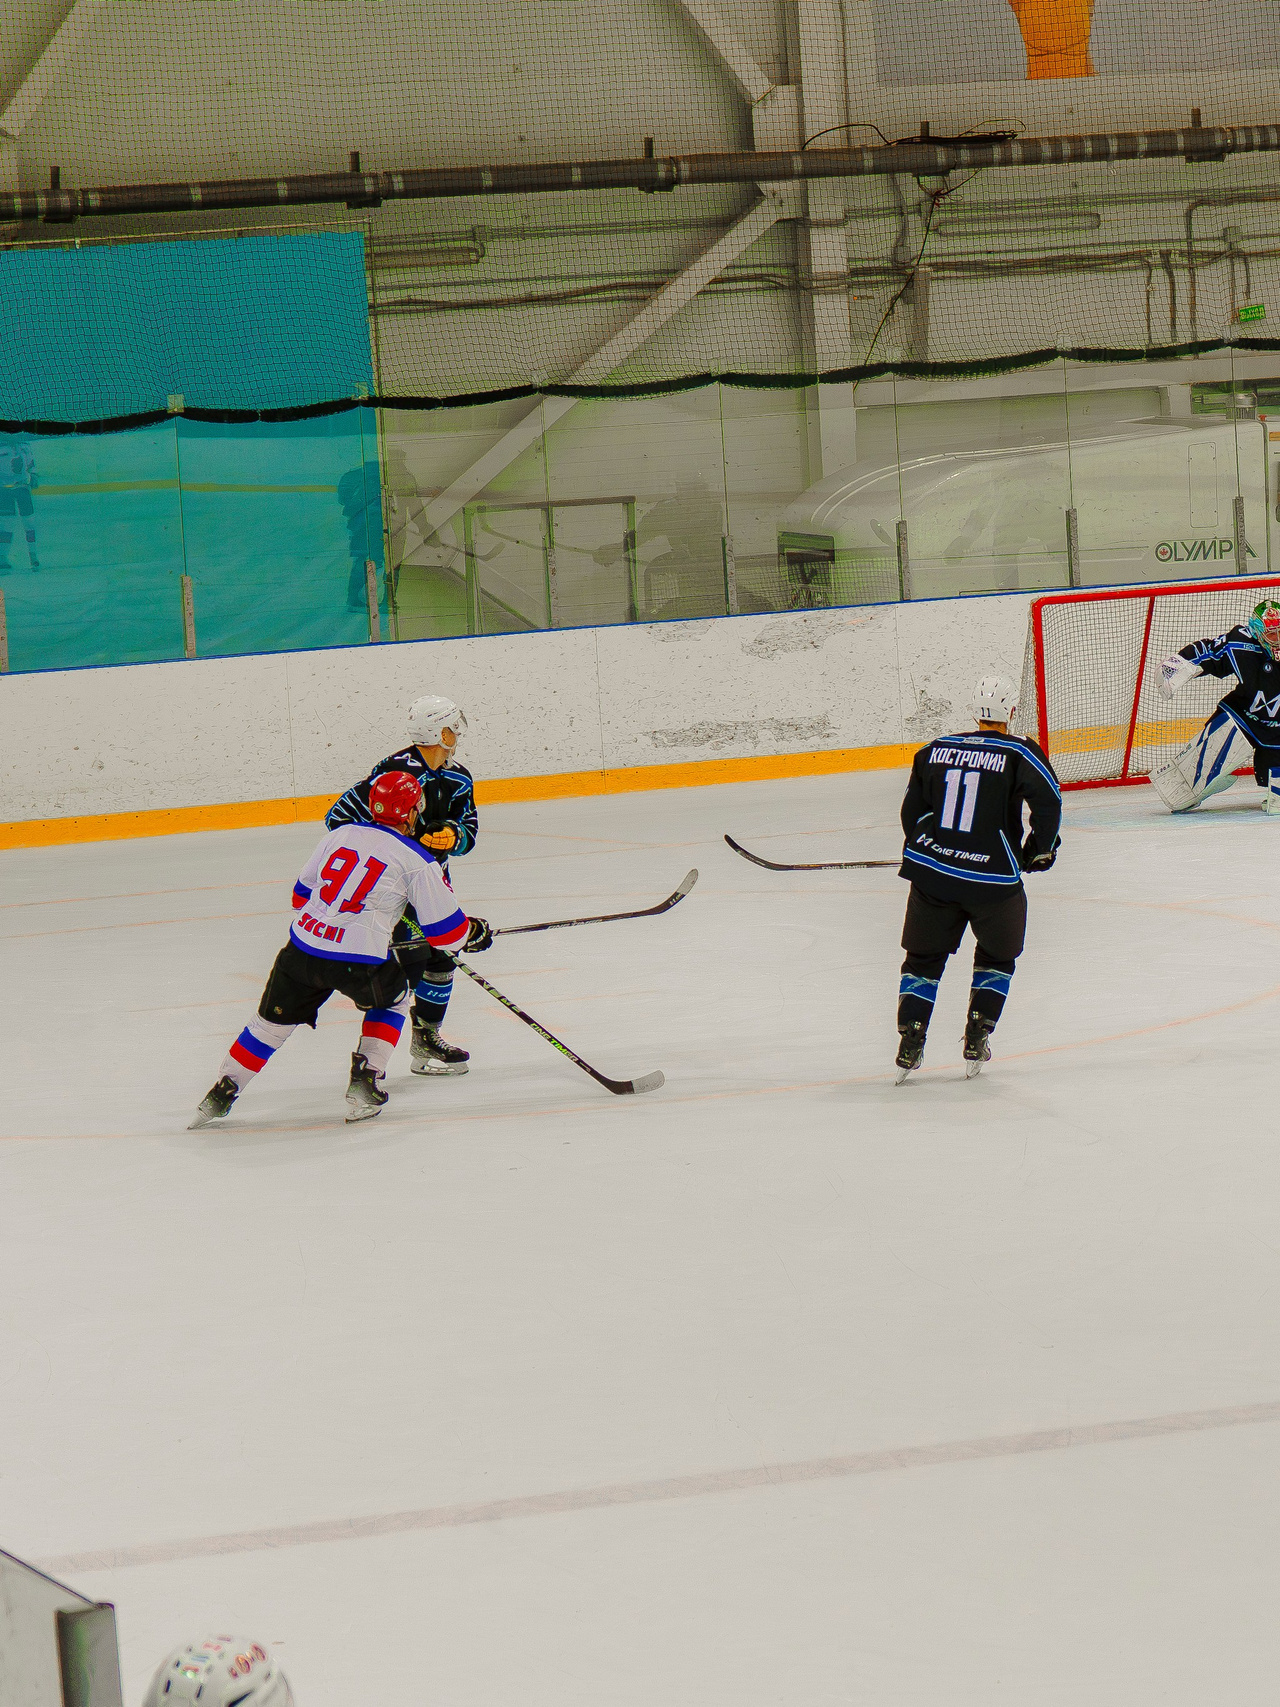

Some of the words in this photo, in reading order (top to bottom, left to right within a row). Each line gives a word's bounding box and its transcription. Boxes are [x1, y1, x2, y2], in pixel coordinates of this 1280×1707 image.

[1155, 539, 1258, 563] OLYMPA
[980, 706, 992, 718] 11
[929, 747, 1007, 773] КОСТРОМИН
[941, 769, 981, 833] 11
[954, 850, 991, 863] TIMER
[320, 846, 389, 915] 91
[297, 912, 346, 944] SOCHI
[550, 1038, 579, 1062] TIMER
